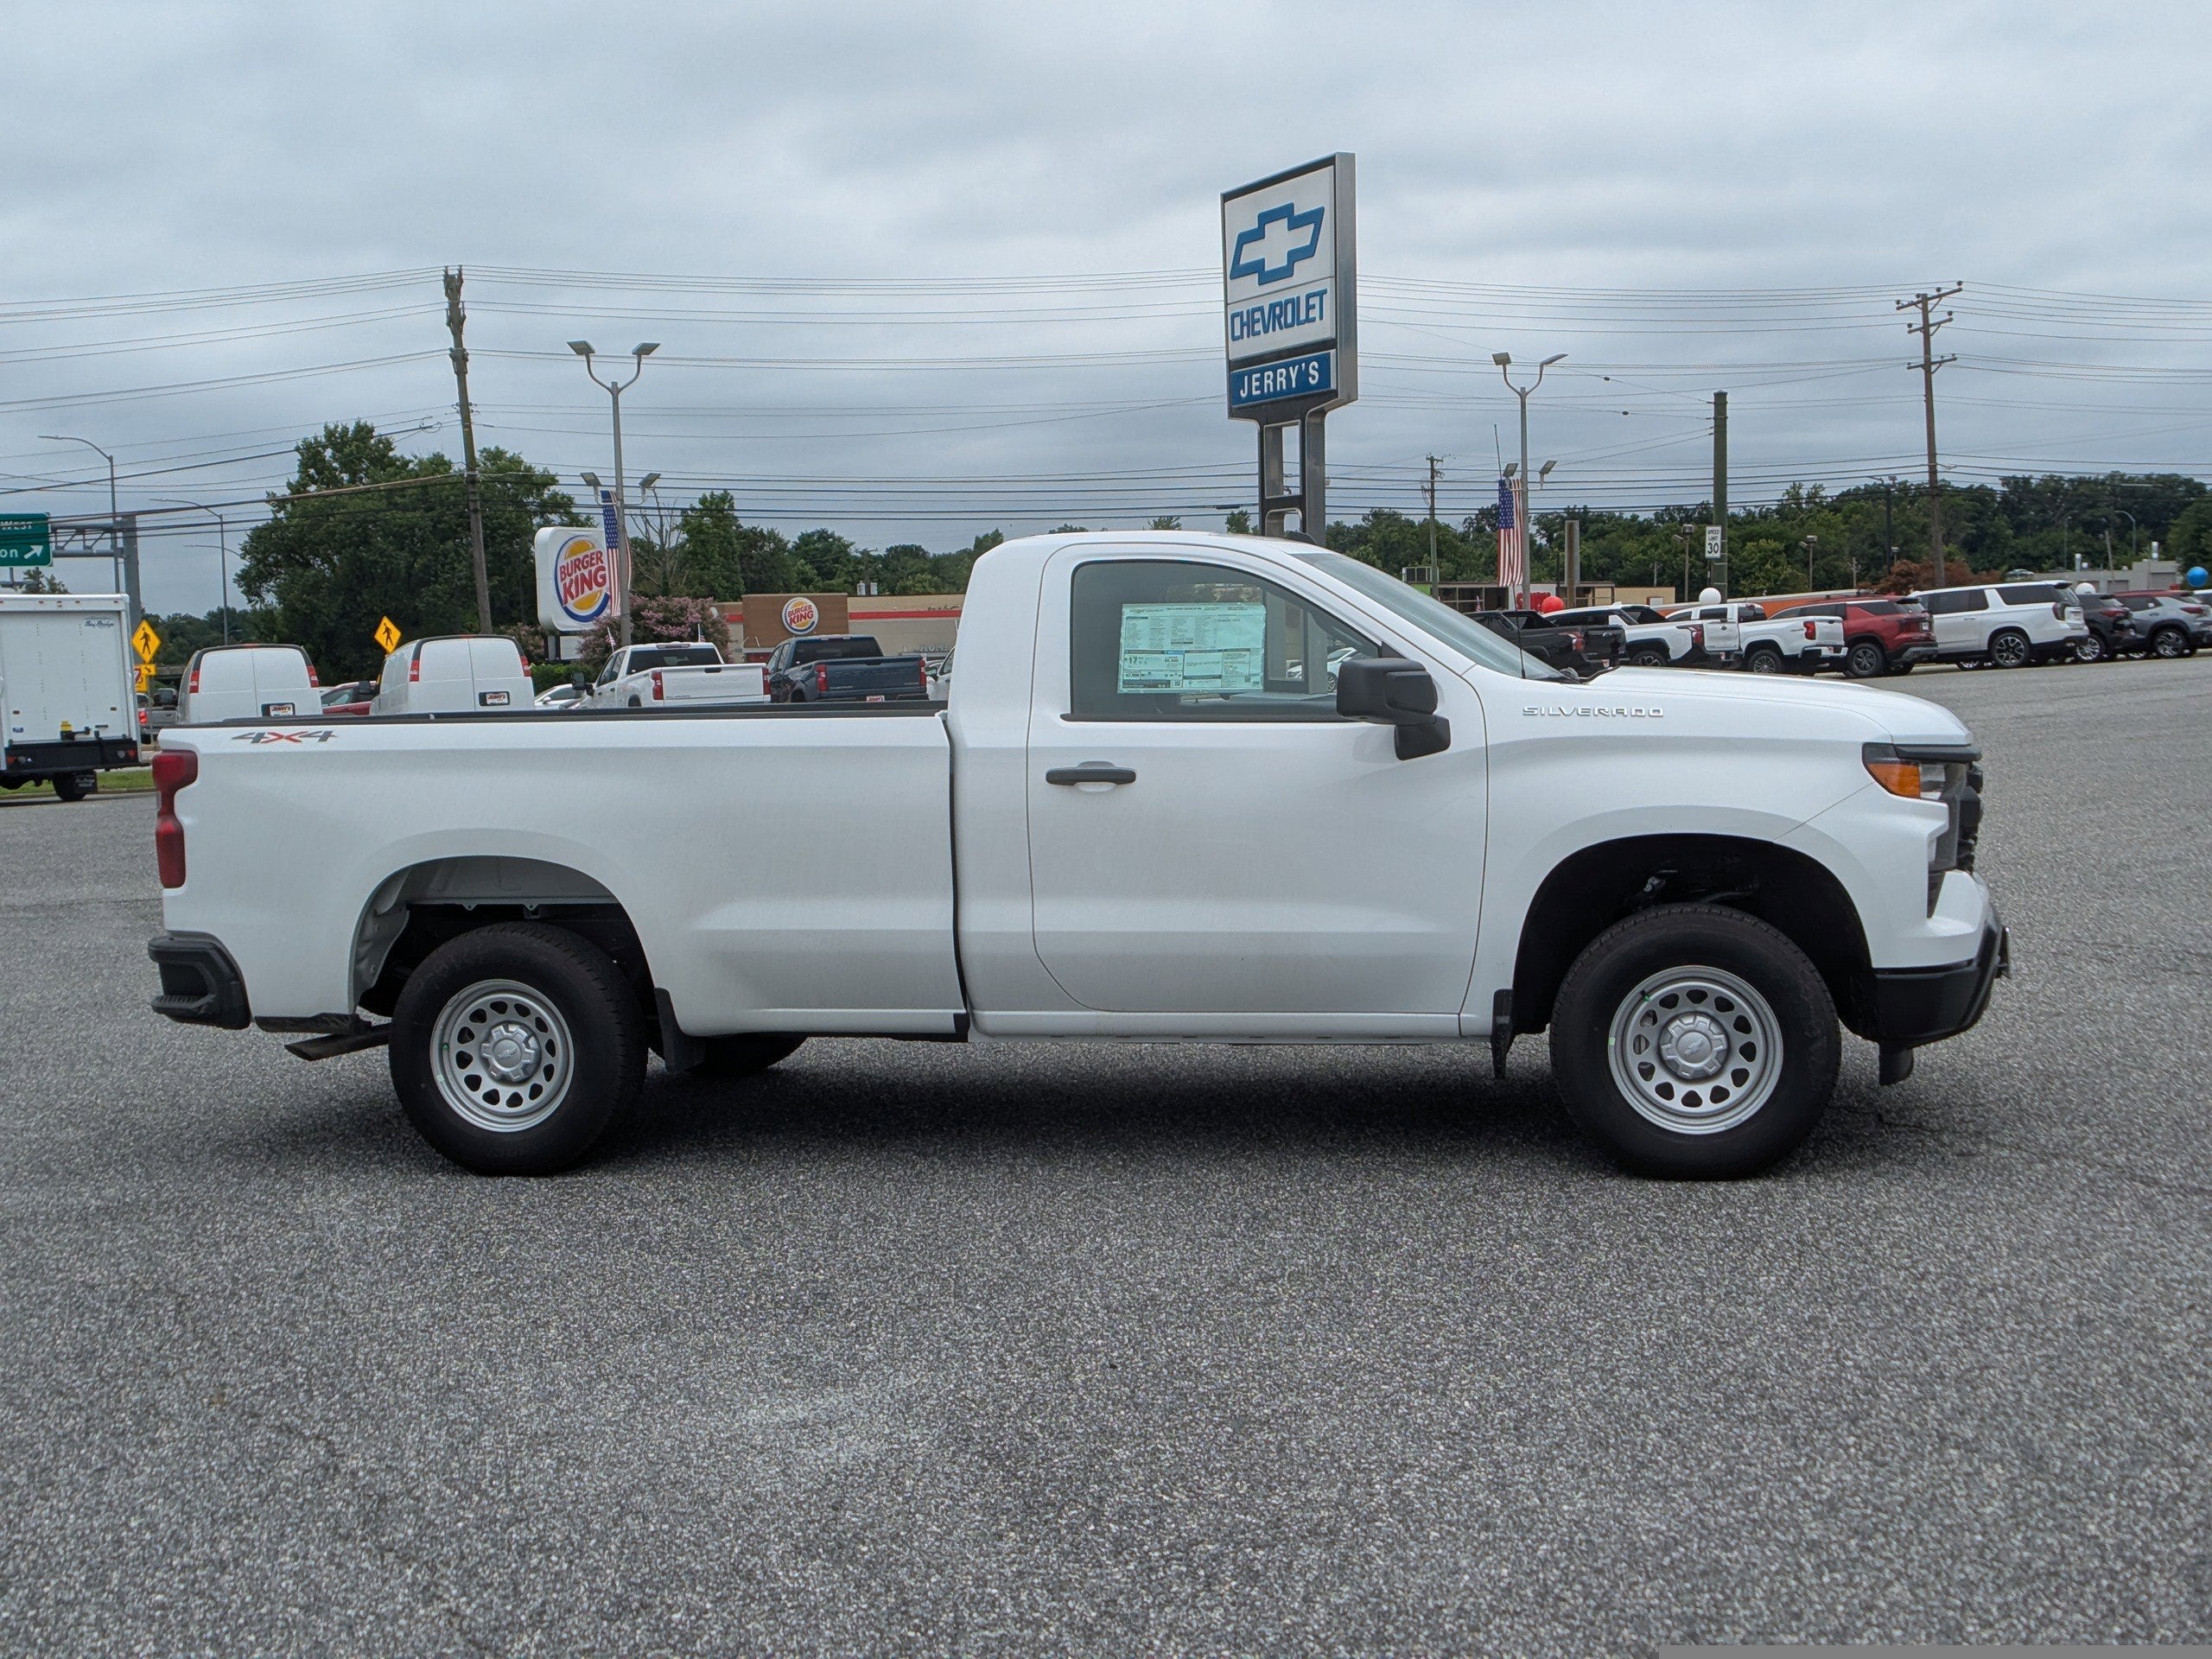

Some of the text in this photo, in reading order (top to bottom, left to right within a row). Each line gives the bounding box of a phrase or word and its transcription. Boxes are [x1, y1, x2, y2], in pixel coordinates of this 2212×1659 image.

[1230, 289, 1327, 341] CHEVROLET
[1240, 361, 1319, 397] JERRY'S
[1707, 543, 1719, 554] 30
[559, 550, 604, 582] BURGER
[563, 565, 607, 606] KING
[787, 604, 812, 618] BURGER
[789, 610, 814, 626] KING
[1522, 706, 1664, 718] SILVERADO
